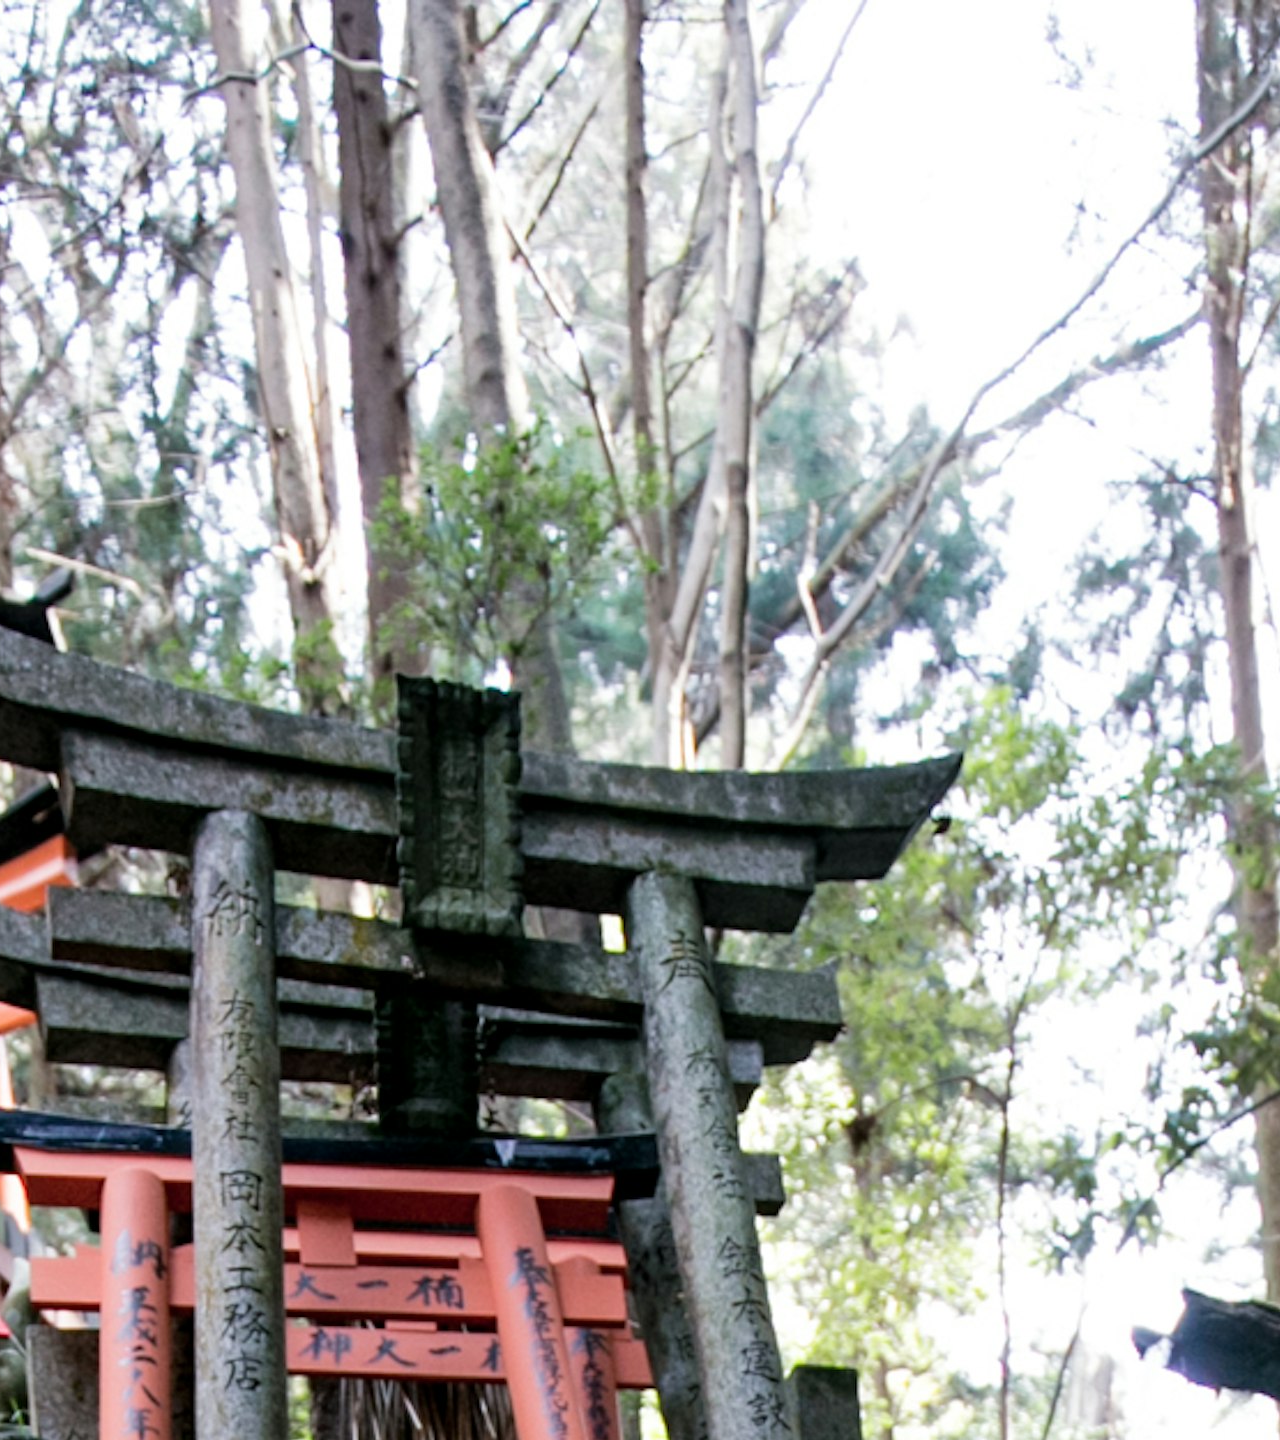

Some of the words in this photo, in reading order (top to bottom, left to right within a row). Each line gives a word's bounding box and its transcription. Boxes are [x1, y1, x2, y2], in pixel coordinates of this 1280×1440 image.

[201, 878, 267, 946] 納
[219, 1170, 271, 1392] 岡本工務店
